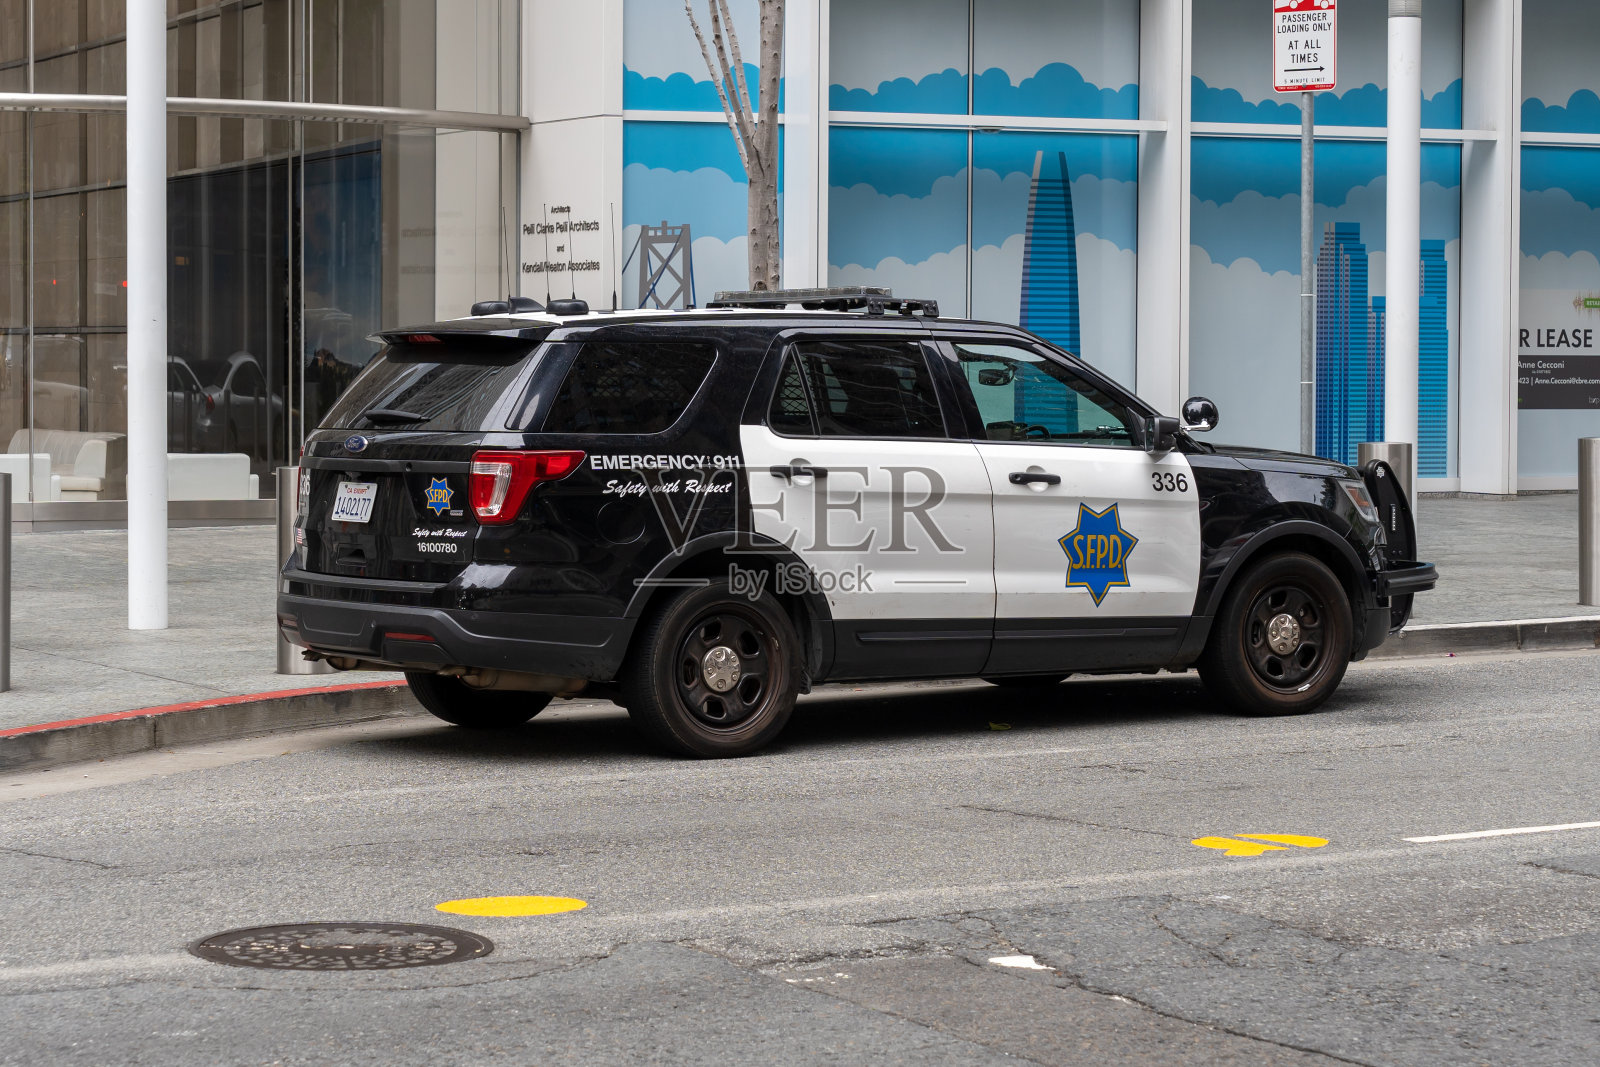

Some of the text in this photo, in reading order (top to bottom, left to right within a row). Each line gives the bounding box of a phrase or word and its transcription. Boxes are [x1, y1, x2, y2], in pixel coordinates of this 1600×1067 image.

[1282, 12, 1327, 23] PASSENGER
[1277, 22, 1332, 34] LOADING ONLY
[1288, 38, 1322, 50] AT ALL
[1291, 53, 1319, 63] TIMES
[551, 205, 571, 214] Architects
[523, 220, 600, 235] Pelli Clarke Pelli Architects
[556, 244, 565, 253] and
[522, 259, 600, 274] Kendall/Heaton Associates
[1519, 328, 1593, 348] R LEASE
[1518, 360, 1565, 369] Anne Cecconi
[590, 454, 741, 470] EMERGENCY 911
[1151, 471, 1189, 493] 336
[602, 479, 733, 498] Safety with Respect
[335, 496, 372, 517] 1402177
[412, 527, 468, 538] Safety with Respect
[417, 542, 458, 553] 16100780
